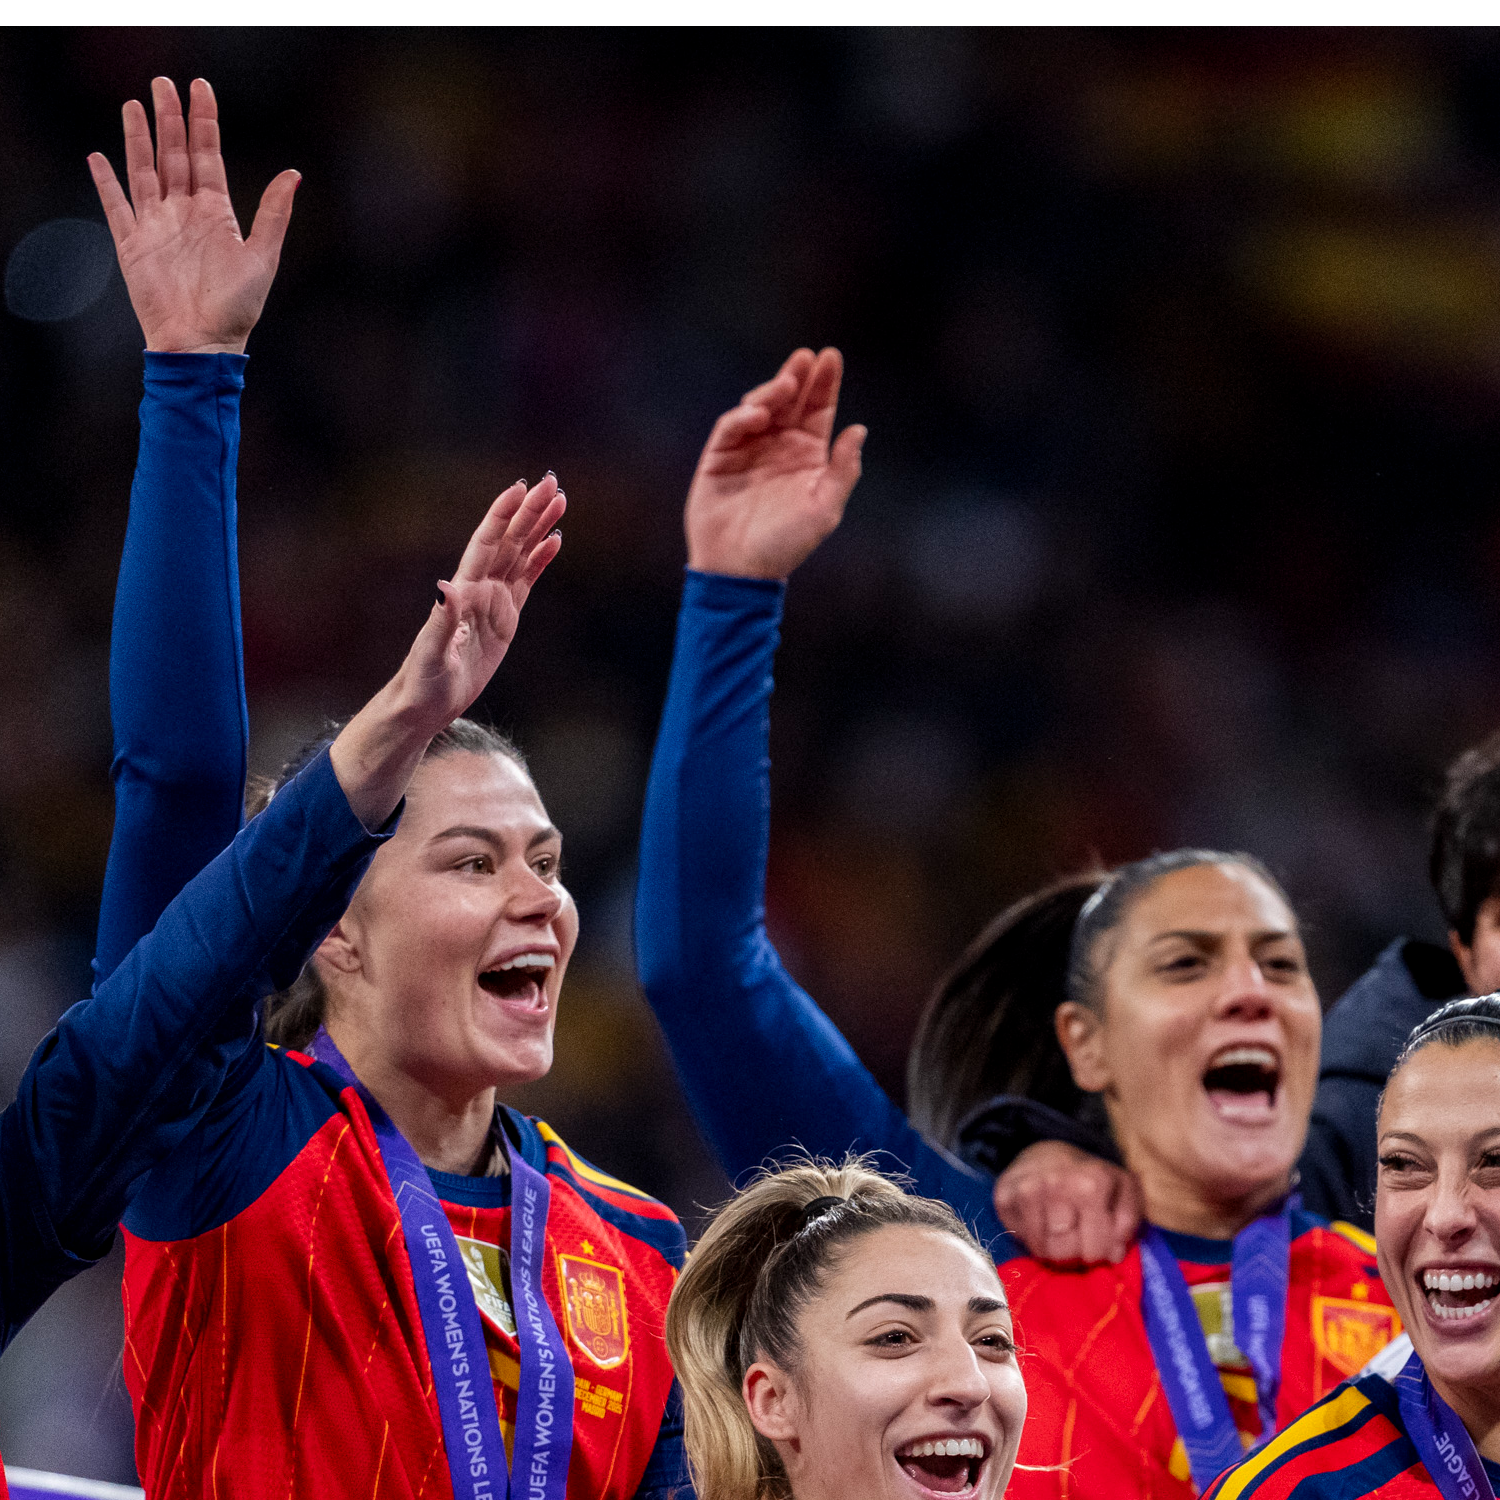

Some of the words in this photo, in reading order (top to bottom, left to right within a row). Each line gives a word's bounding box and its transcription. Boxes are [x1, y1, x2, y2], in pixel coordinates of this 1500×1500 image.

[522, 1187, 538, 1267] LEAGUE
[518, 1266, 548, 1346] NATIONS
[421, 1224, 448, 1273] UEFA
[435, 1273, 470, 1377] WOMEN'S
[455, 1379, 488, 1478] NATIONS
[533, 1348, 557, 1447] WOMEN'S
